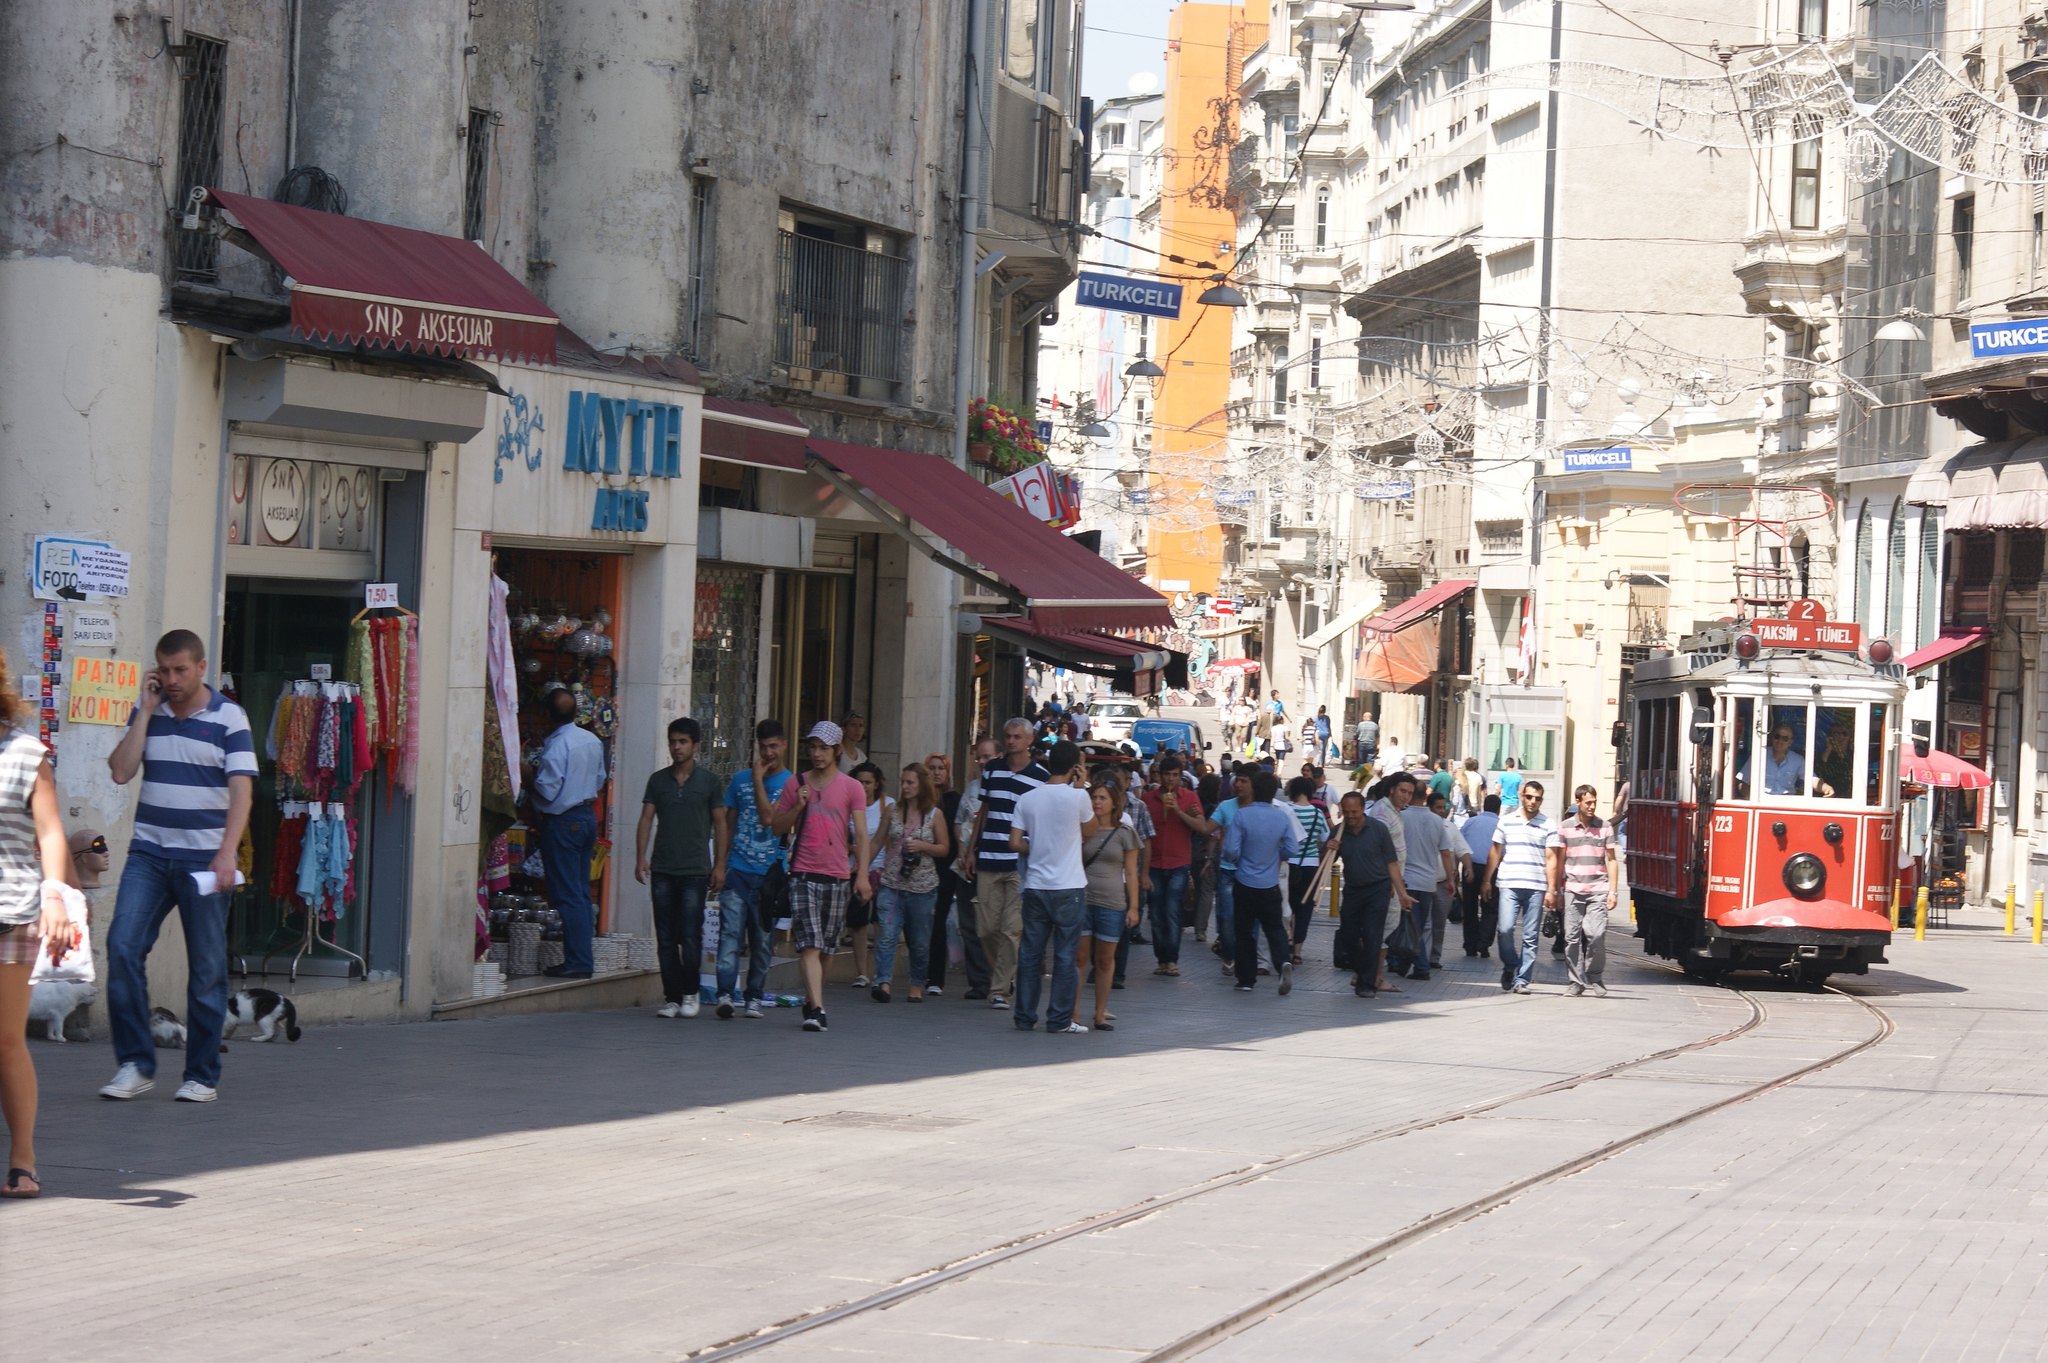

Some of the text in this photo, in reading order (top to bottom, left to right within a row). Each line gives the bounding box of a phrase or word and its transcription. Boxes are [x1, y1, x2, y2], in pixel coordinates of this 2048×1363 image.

[1082, 279, 1178, 310] TURKCELL
[365, 303, 493, 347] SNR AKSESUAR
[563, 390, 684, 479] MYTH
[1565, 452, 1631, 466] TURKCELL
[272, 465, 296, 499] SNR
[266, 506, 299, 521] AKSESUAR
[591, 488, 650, 533] ARTS
[79, 617, 110, 626] TELEFON
[1801, 601, 1815, 620] 2
[1757, 624, 1798, 641] TAKSİM
[1816, 626, 1853, 644] TÜNEL
[76, 657, 137, 690] PARÇA
[1715, 815, 1733, 833] 223
